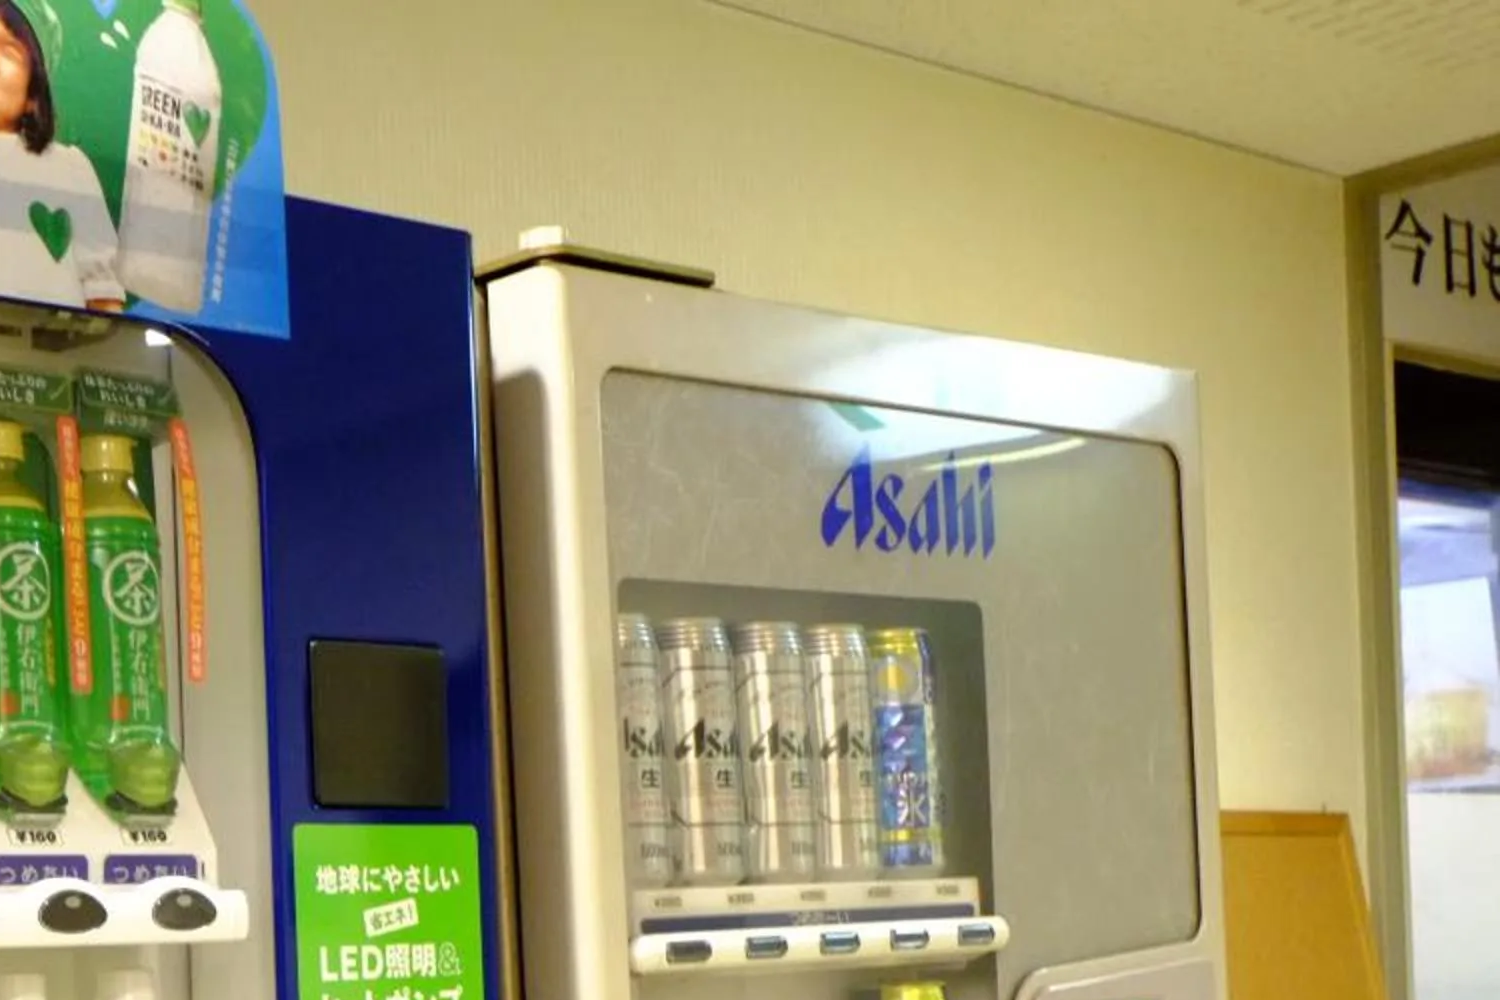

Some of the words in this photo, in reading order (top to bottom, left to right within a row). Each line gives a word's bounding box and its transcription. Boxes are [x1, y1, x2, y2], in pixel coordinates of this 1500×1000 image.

[820, 442, 996, 561] Asahi
[0, 551, 49, 610] 茶
[113, 561, 157, 617] 茶
[15, 829, 58, 844] ¥160
[128, 829, 168, 843] ¥160
[315, 864, 461, 895] 地球にやさしい
[368, 903, 415, 932] 省エネ!
